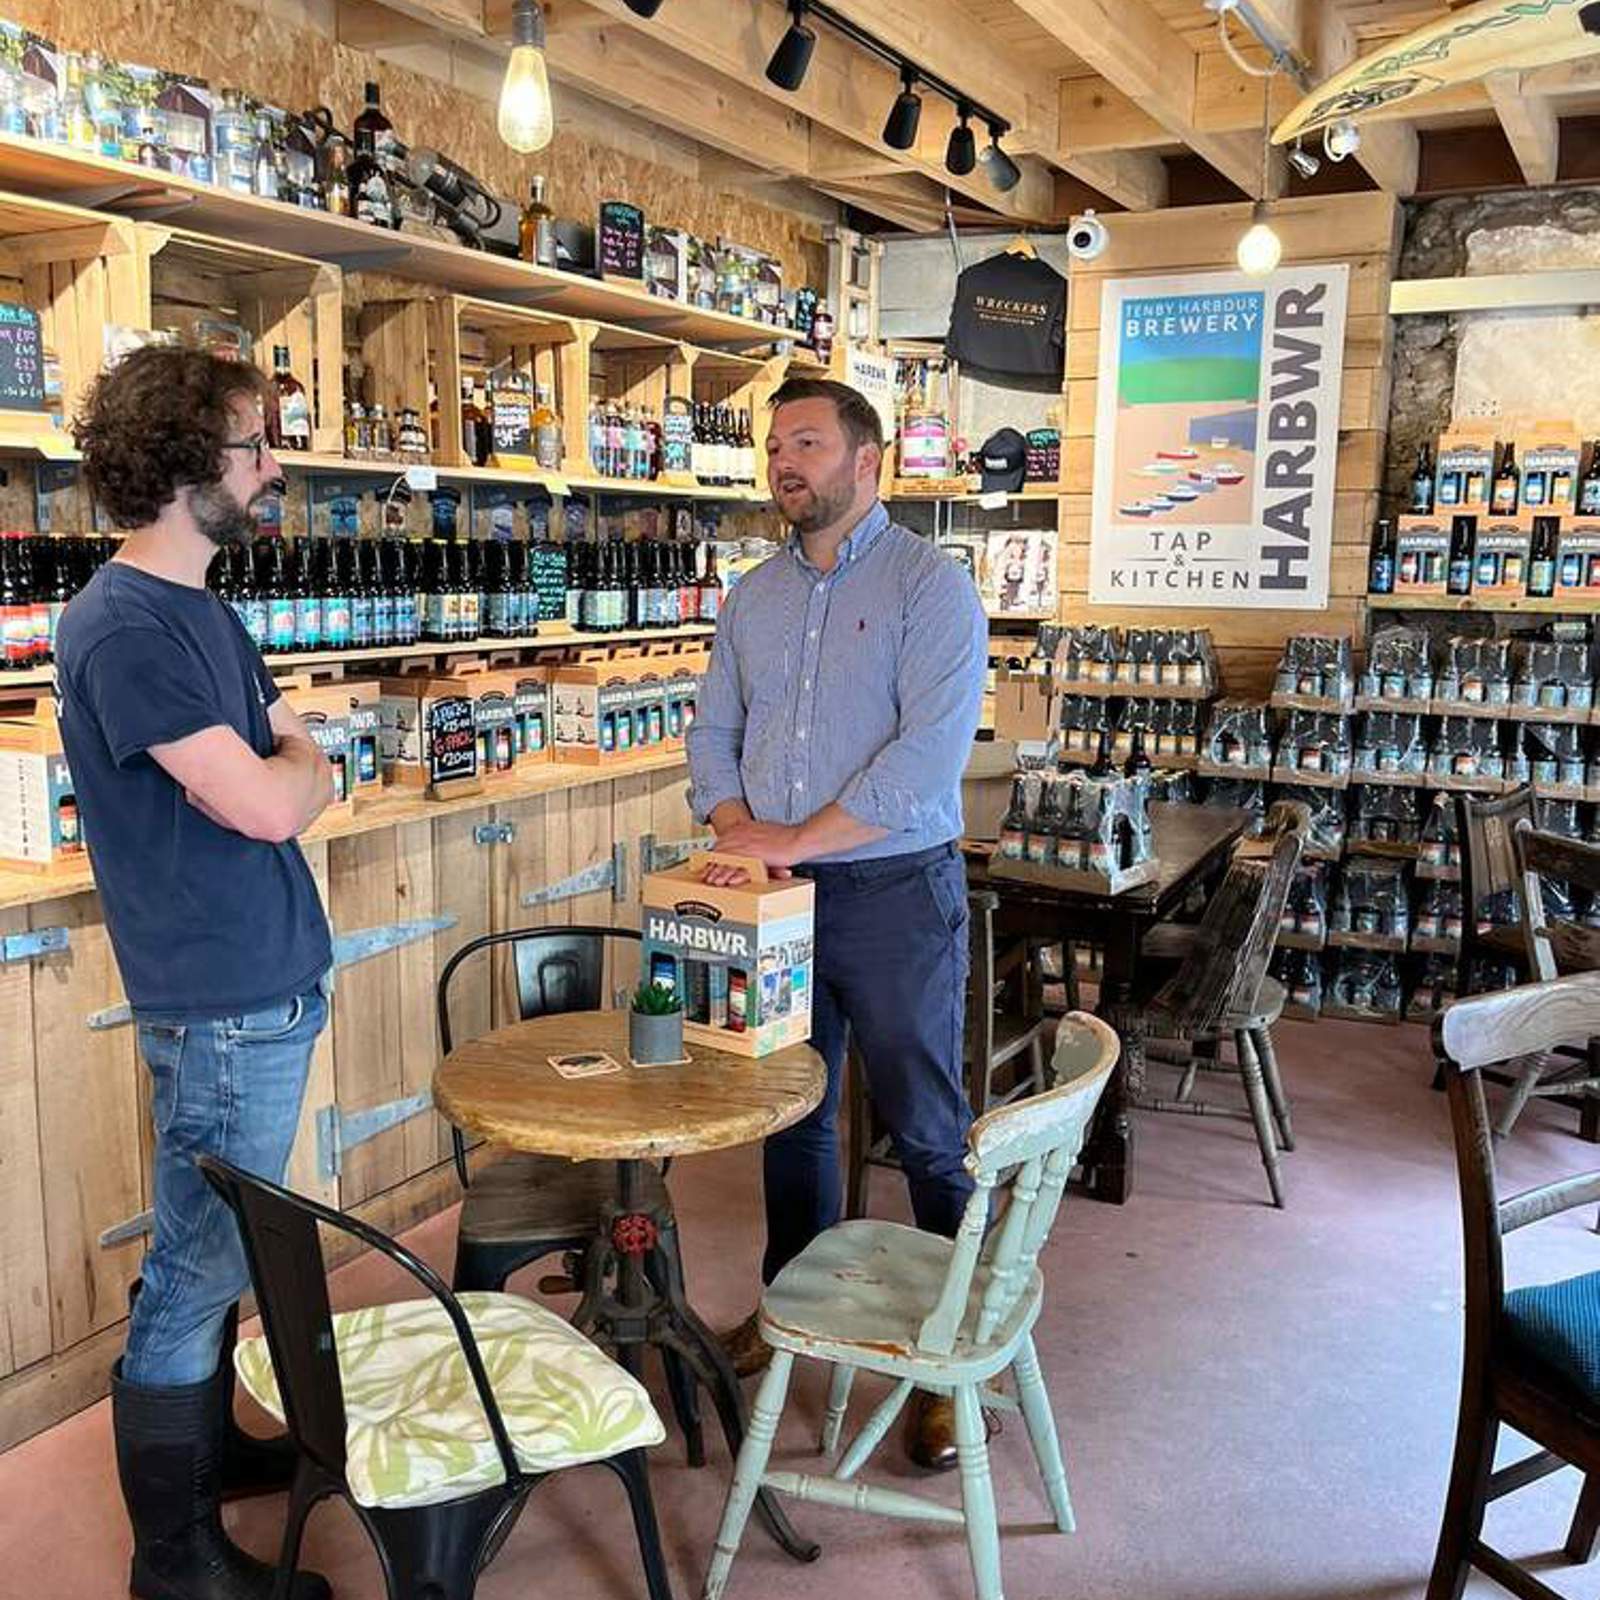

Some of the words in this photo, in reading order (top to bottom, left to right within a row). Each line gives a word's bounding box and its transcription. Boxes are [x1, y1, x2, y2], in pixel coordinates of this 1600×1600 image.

[1125, 303, 1175, 318] TENBY
[1178, 298, 1259, 315] HARBOUR
[1125, 312, 1257, 338] BREWERY
[1259, 283, 1327, 590] HARBWR
[1150, 532, 1212, 551] TAP
[1173, 554, 1186, 567] &
[1110, 570, 1249, 589] KITCHEN
[649, 917, 748, 957] HARBWR
